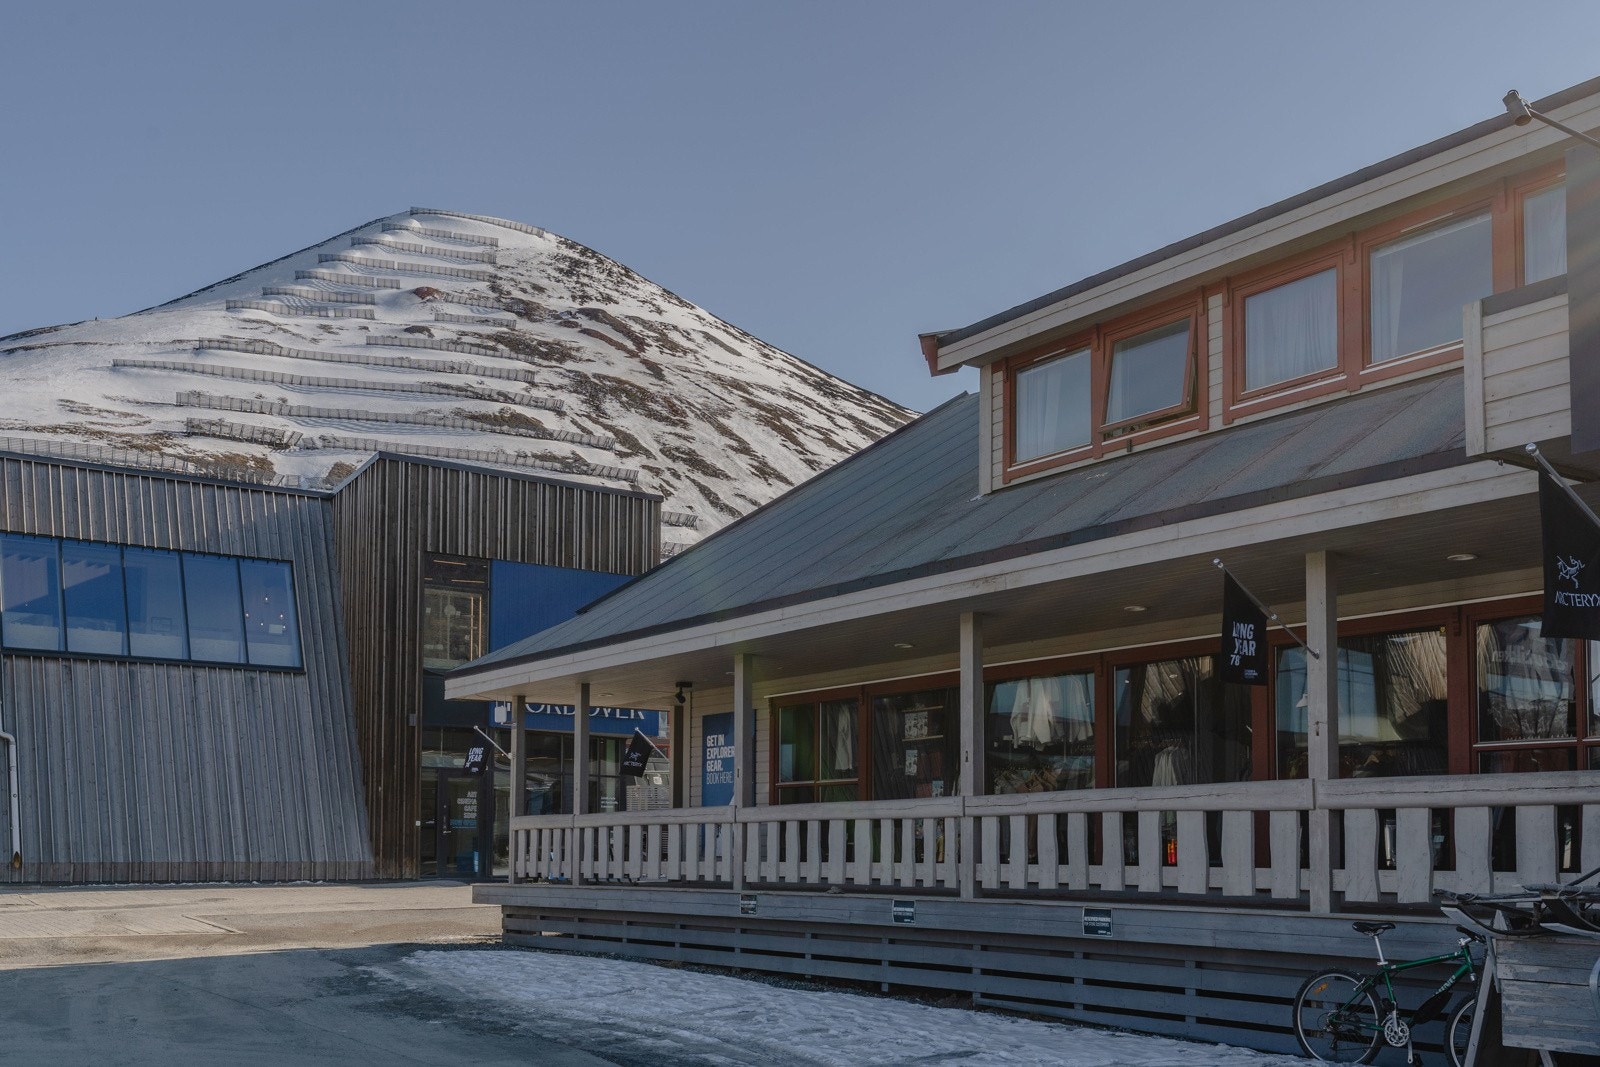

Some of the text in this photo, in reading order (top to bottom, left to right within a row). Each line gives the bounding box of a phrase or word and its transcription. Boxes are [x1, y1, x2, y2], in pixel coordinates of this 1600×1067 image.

[1232, 621, 1255, 640] LONG
[1233, 638, 1256, 657] YEAR
[706, 734, 725, 747] GET IN
[706, 760, 724, 772] GEAR.
[706, 772, 720, 785] BOOK
